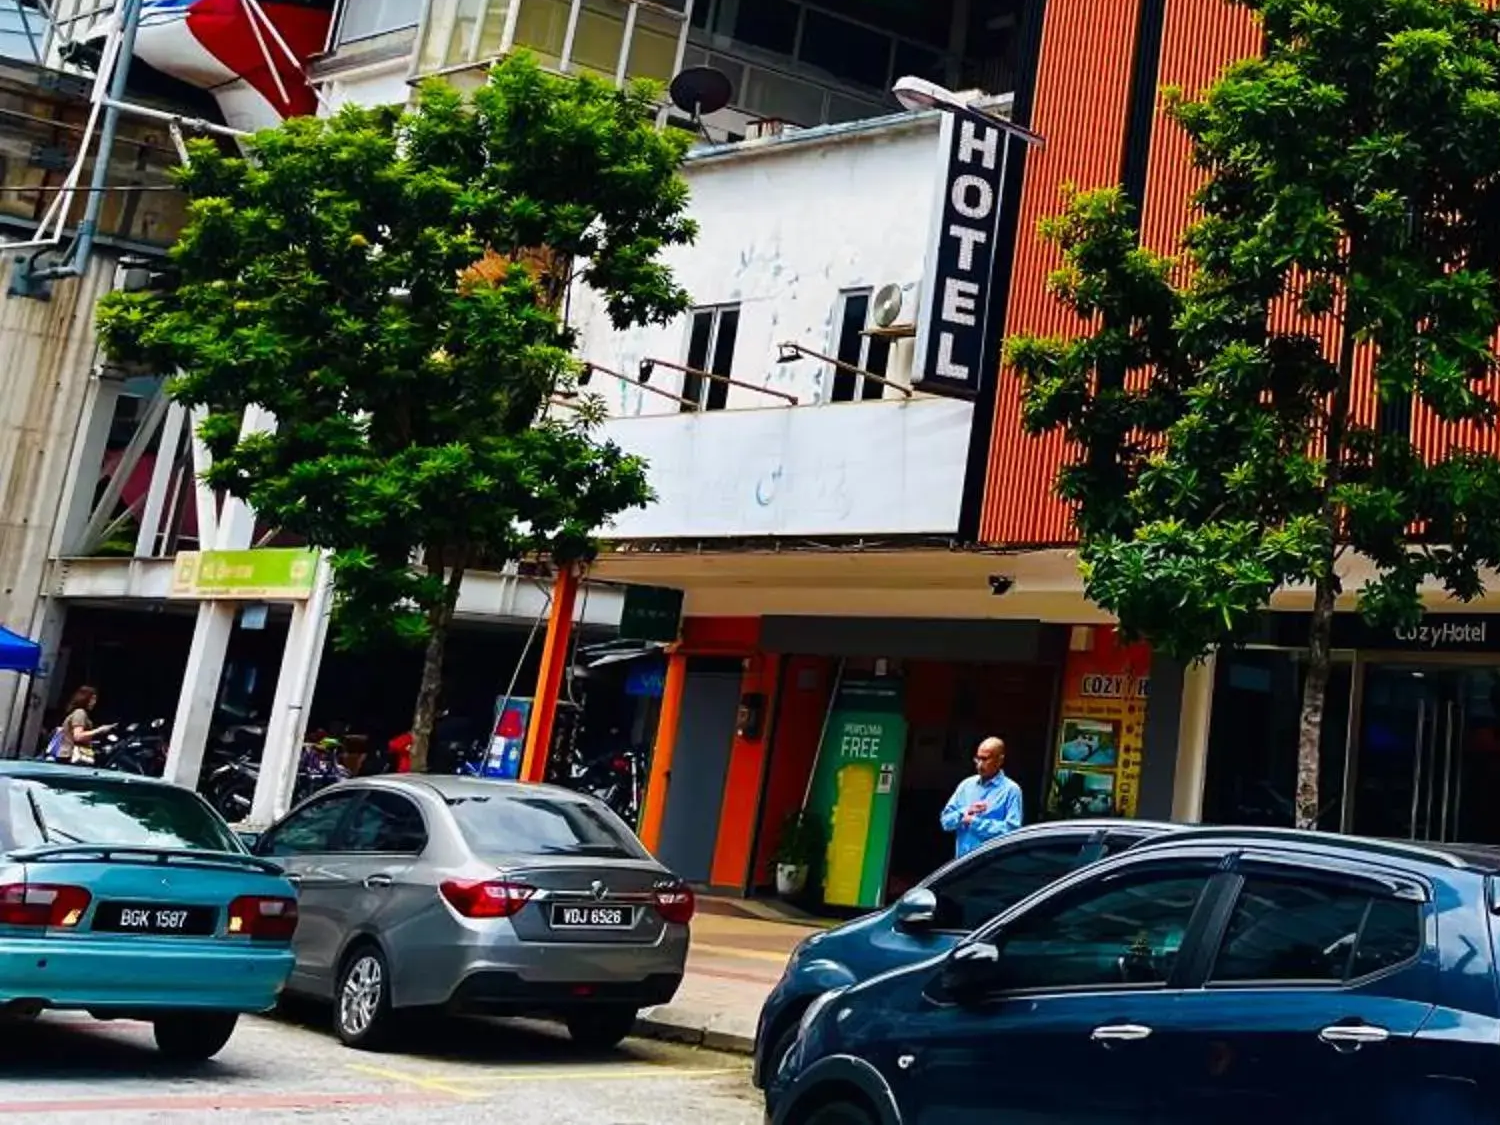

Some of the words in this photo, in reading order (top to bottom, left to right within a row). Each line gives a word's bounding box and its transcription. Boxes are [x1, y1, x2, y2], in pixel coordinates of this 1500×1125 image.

[936, 120, 999, 380] HOTEL
[1082, 674, 1123, 696] COZY
[841, 736, 881, 758] FREE
[120, 908, 151, 928] BGK
[155, 909, 188, 928] 1587
[563, 908, 588, 924] VDJ
[591, 909, 622, 924] 6526
